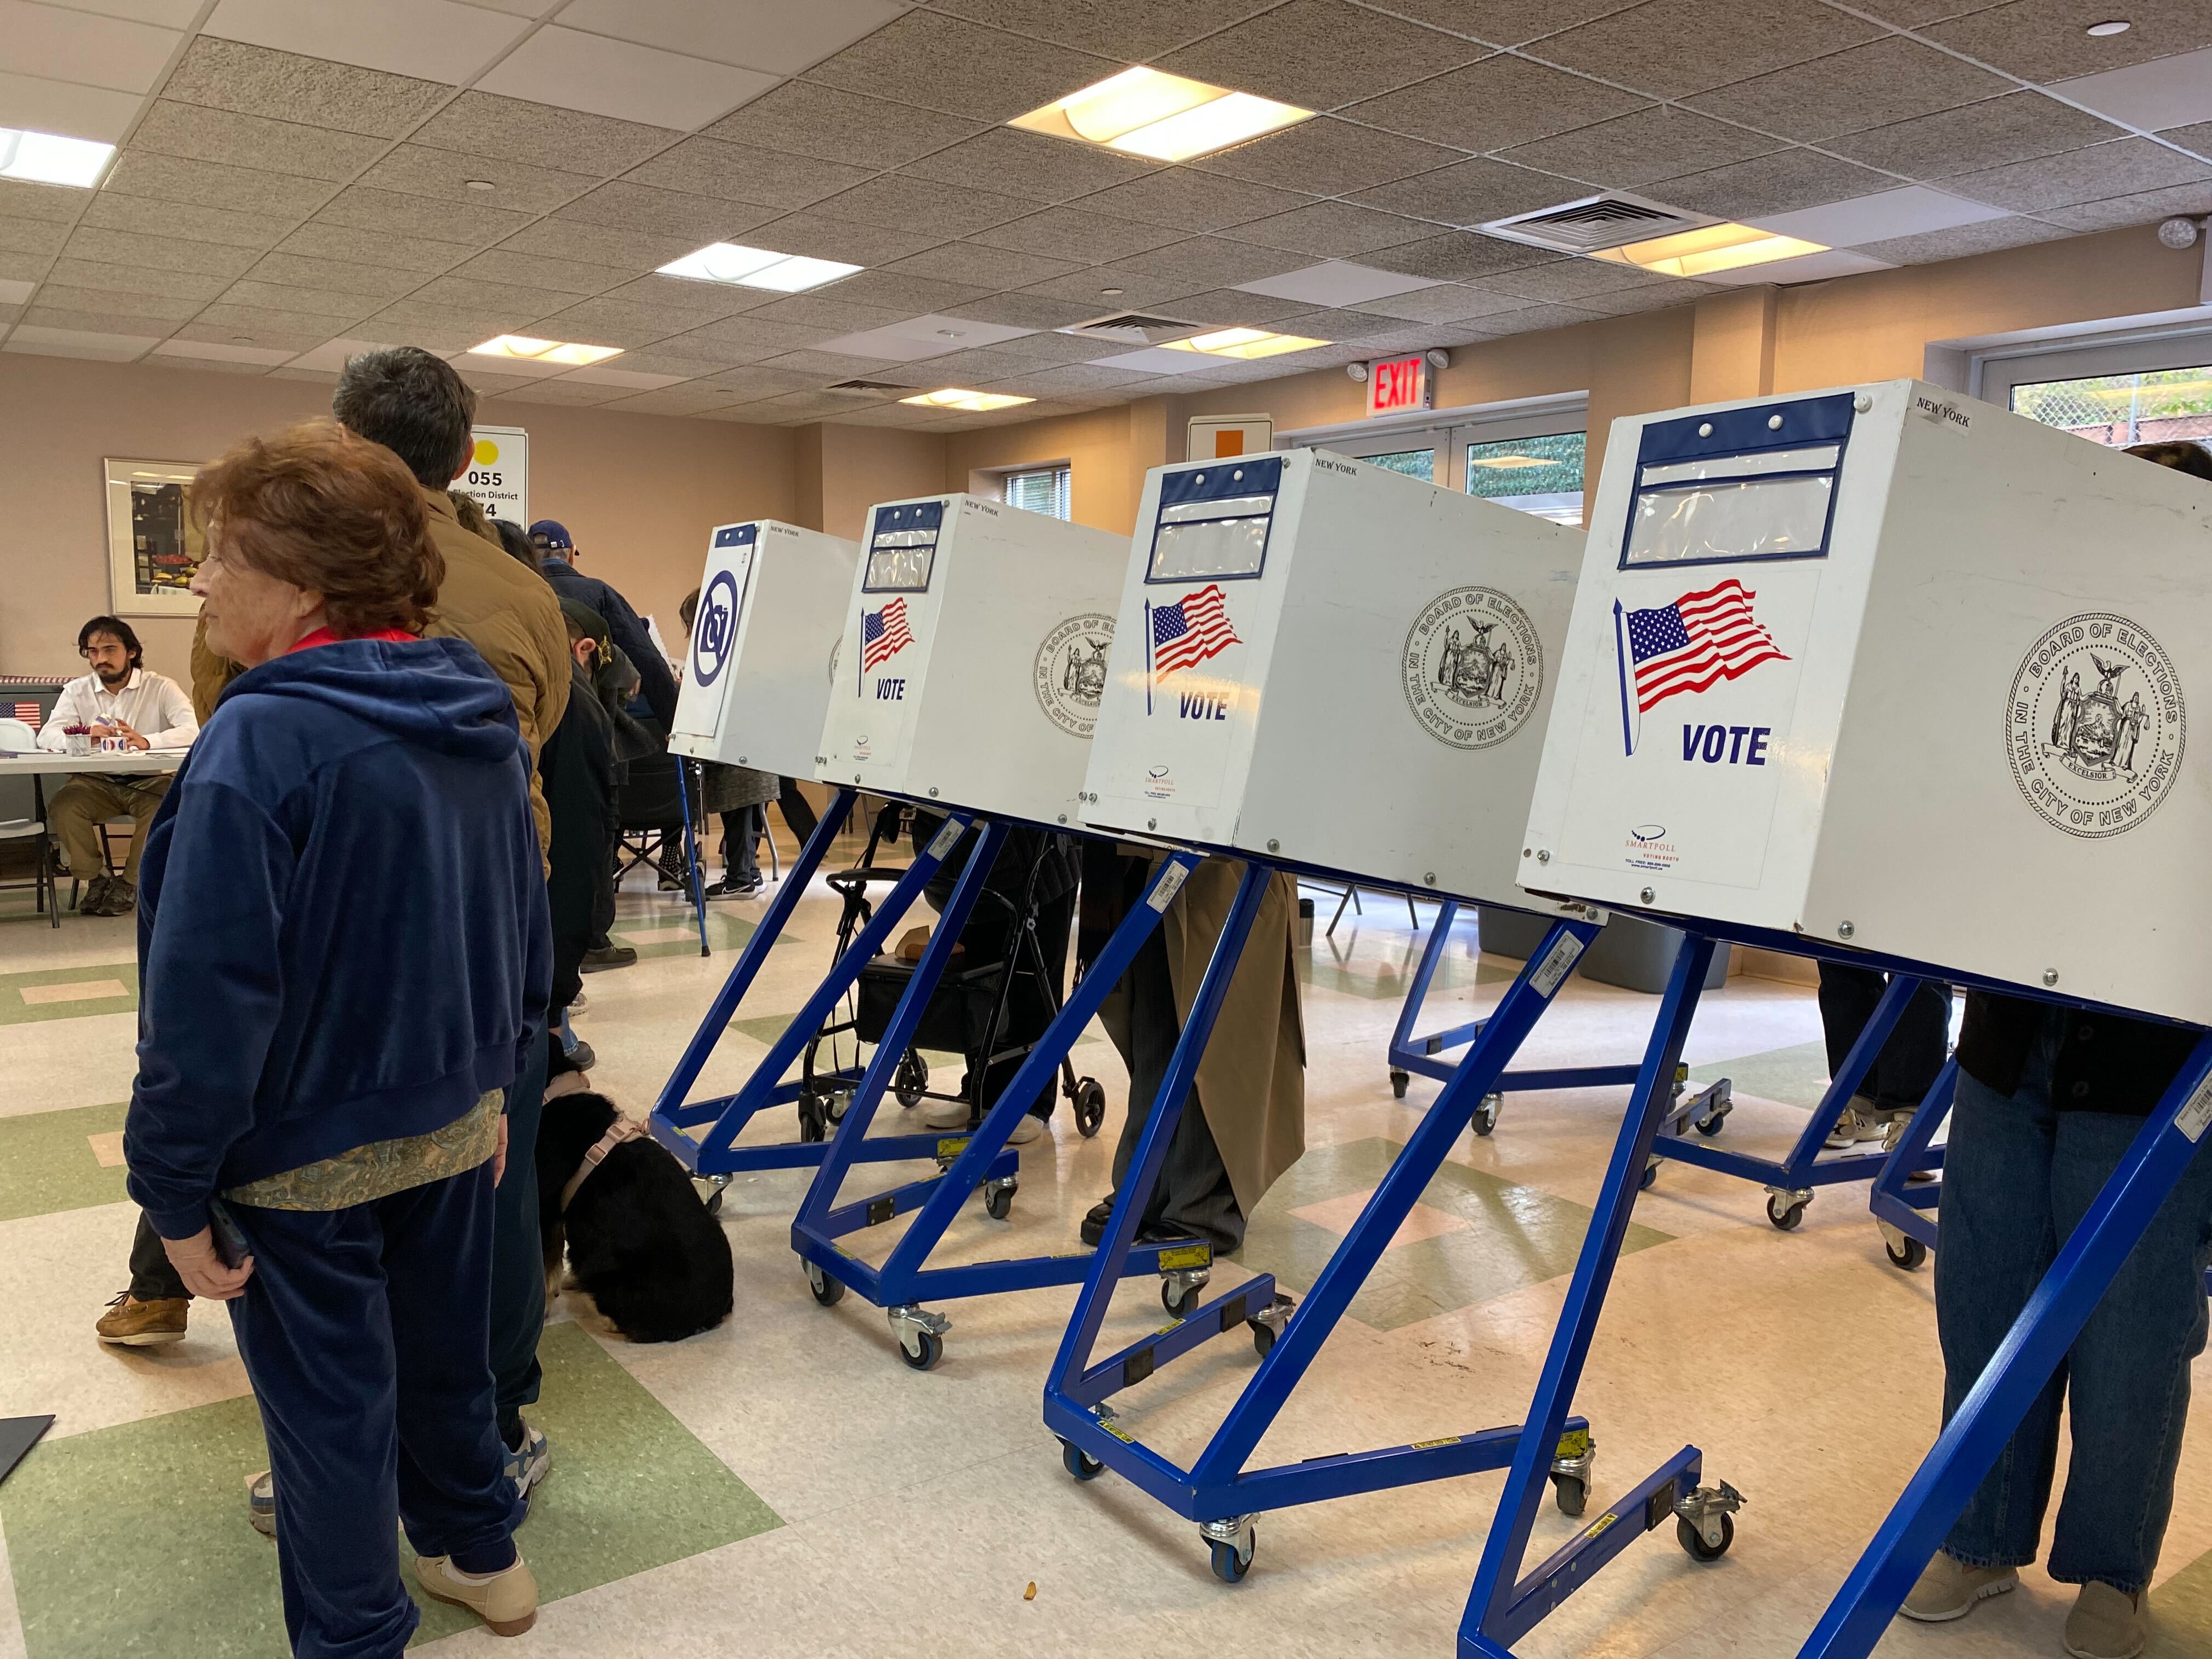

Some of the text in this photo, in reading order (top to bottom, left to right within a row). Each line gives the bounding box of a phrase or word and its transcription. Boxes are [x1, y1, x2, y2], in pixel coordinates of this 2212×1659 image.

[1374, 358, 1421, 409] EXIT
[1917, 397, 1970, 428] NEW YORK
[469, 471, 502, 486] 055
[1315, 459, 1357, 476] NEW YORK
[488, 491, 518, 500] District
[965, 500, 998, 516] NEW YORK
[478, 503, 496, 516] 4
[784, 528, 799, 537] YORK
[1046, 623, 1080, 653] BOARD
[1084, 620, 1098, 629] OF
[1419, 594, 1536, 665] BOARD OF ELECTIONS
[2029, 623, 2178, 723] BOARD OF ELECTIONS
[877, 678, 906, 700] VOTE
[1039, 667, 1093, 732] IN THE CITY OF
[1409, 653, 1534, 741] IN THE CITY OF NEW YORK
[1452, 695, 1483, 707] EXCELSIOR
[1181, 691, 1229, 720] VOTE
[1683, 724, 1771, 765] VOTE
[2015, 702, 2174, 826] IN THE CITY OF NEW YORK
[2068, 762, 2108, 779] EXCELSIOR
[1625, 840, 1676, 852] SMARTPOLL
